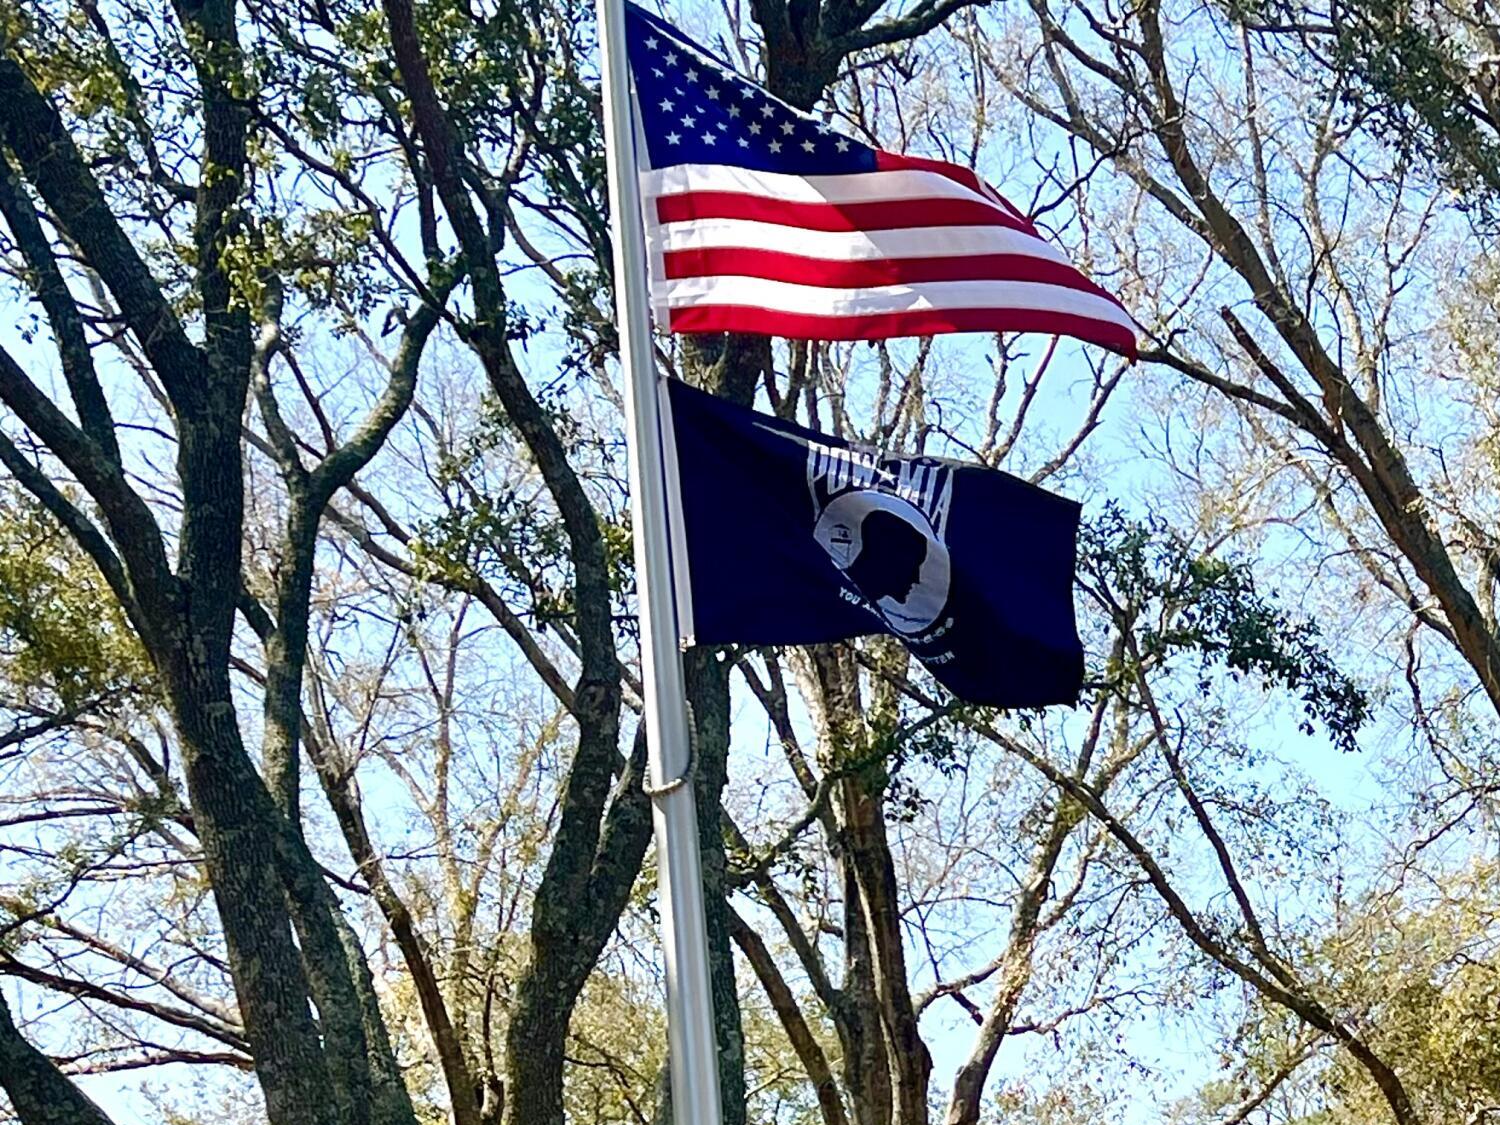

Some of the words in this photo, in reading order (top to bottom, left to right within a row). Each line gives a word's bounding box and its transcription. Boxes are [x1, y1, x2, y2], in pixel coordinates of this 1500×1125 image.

[807, 439, 882, 522] POW
[895, 459, 954, 543] MIA
[839, 586, 861, 605] YOU
